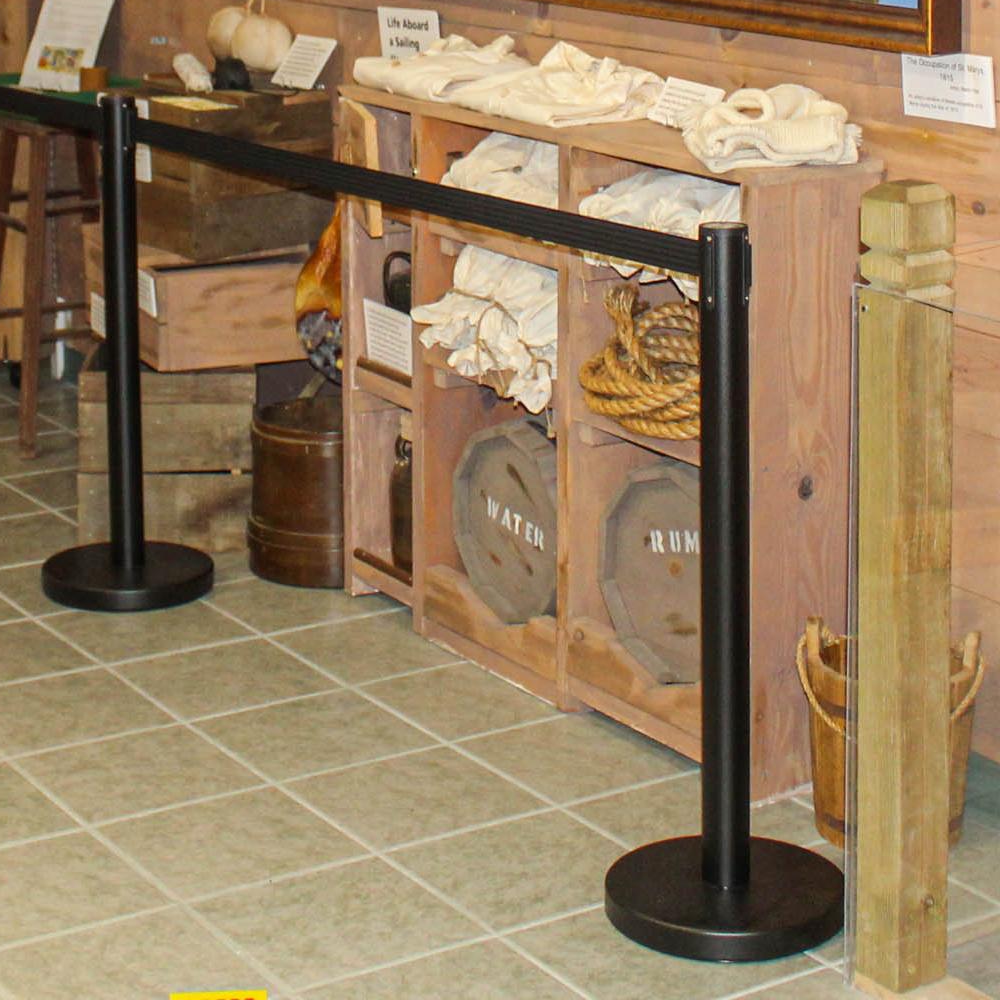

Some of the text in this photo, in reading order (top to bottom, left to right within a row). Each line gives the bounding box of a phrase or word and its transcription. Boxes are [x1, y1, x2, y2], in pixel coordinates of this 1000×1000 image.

[386, 17, 429, 31] Life Aboard
[395, 37, 420, 52] Sailing
[906, 56, 918, 65] The
[918, 57, 951, 70] Occupation
[951, 63, 957, 71] of
[487, 496, 544, 551] WATER
[650, 529, 700, 553] RUM
